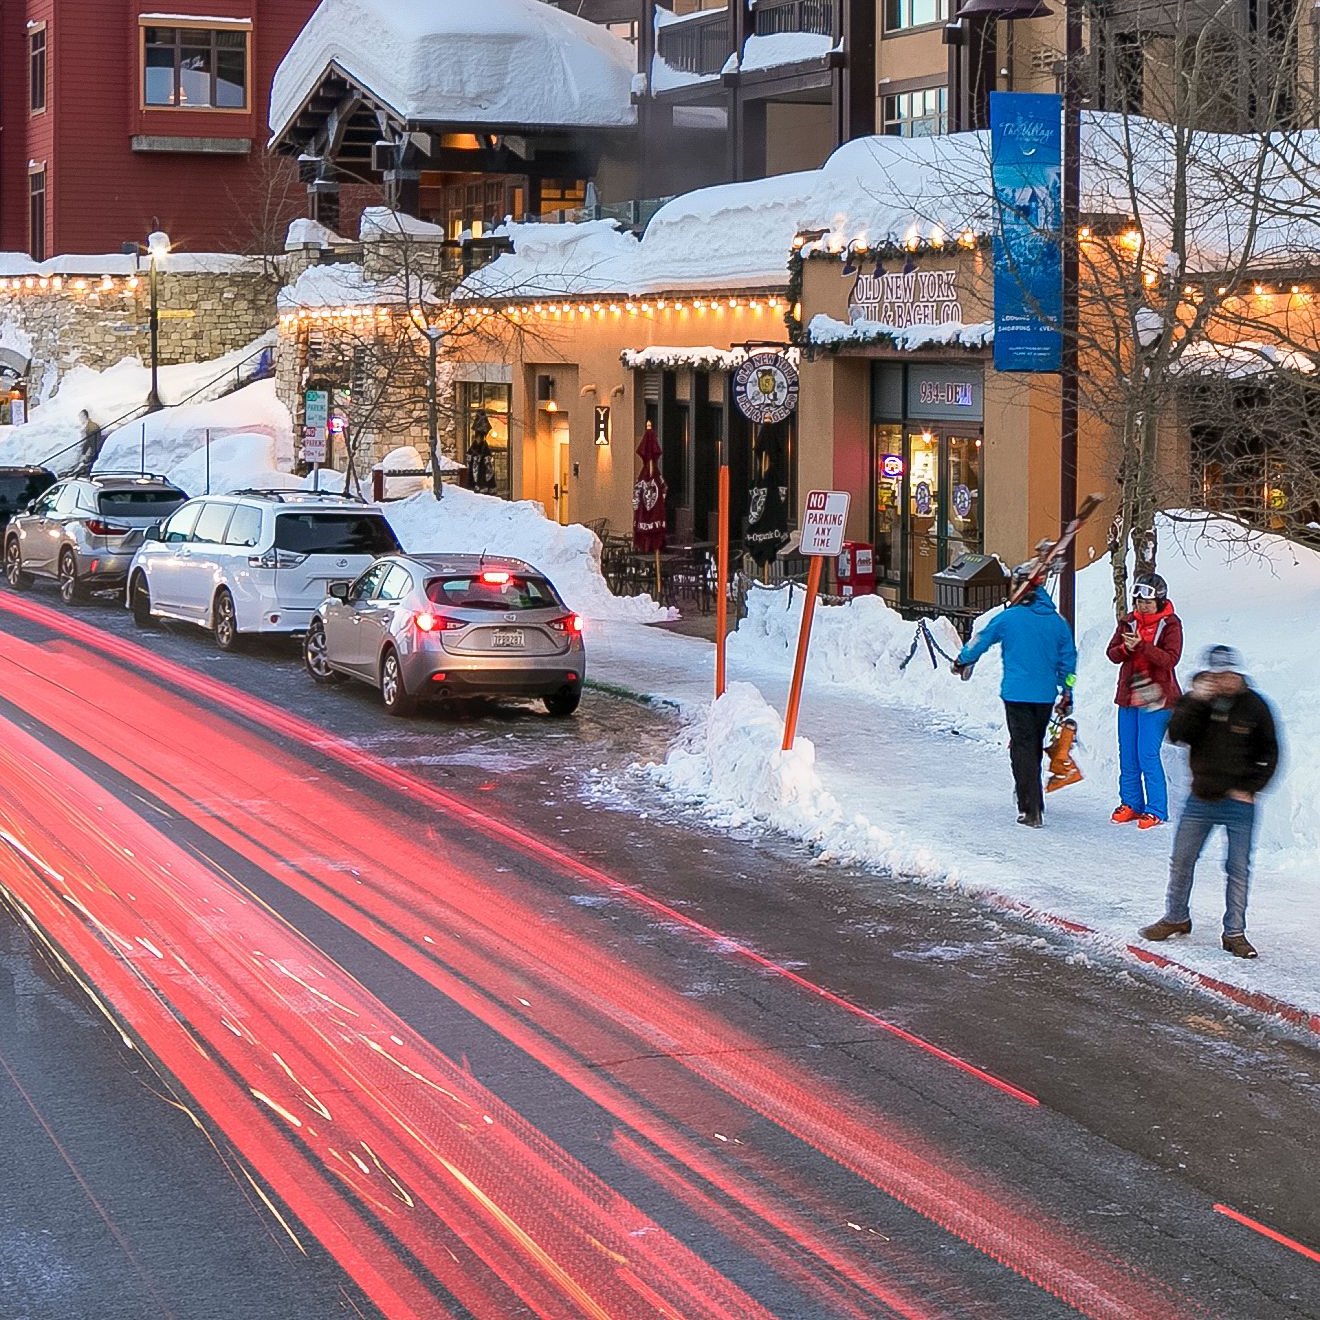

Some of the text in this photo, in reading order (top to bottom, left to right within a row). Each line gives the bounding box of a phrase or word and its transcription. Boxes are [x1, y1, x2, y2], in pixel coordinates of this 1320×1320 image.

[854, 270, 958, 303] OLD NEW YORK
[809, 493, 825, 509] NO
[807, 512, 843, 526] PARKING
[815, 527, 832, 537] ANY
[813, 538, 830, 548] TIME
